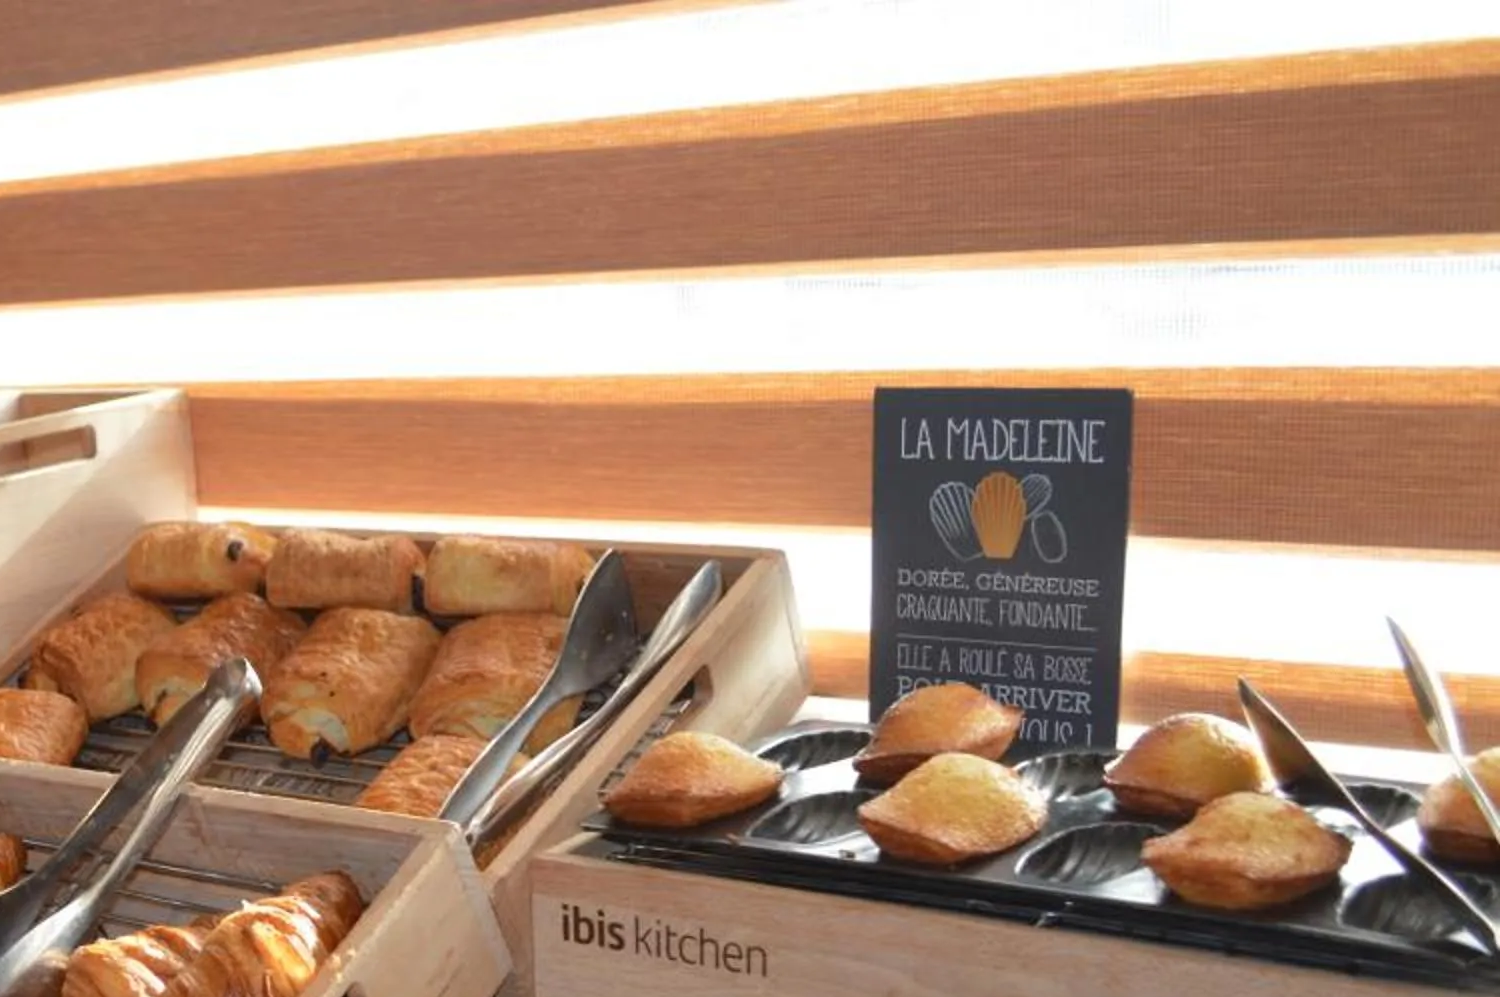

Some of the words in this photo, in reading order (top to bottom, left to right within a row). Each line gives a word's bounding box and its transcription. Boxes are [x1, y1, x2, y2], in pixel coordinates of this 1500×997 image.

[900, 417, 935, 460] LA
[947, 418, 1106, 464] MADELEINE
[897, 643, 933, 671] ELLE
[939, 649, 951, 673] A
[1013, 653, 1036, 682] SA
[561, 903, 626, 951] ibis
[634, 915, 768, 978] kitchen
